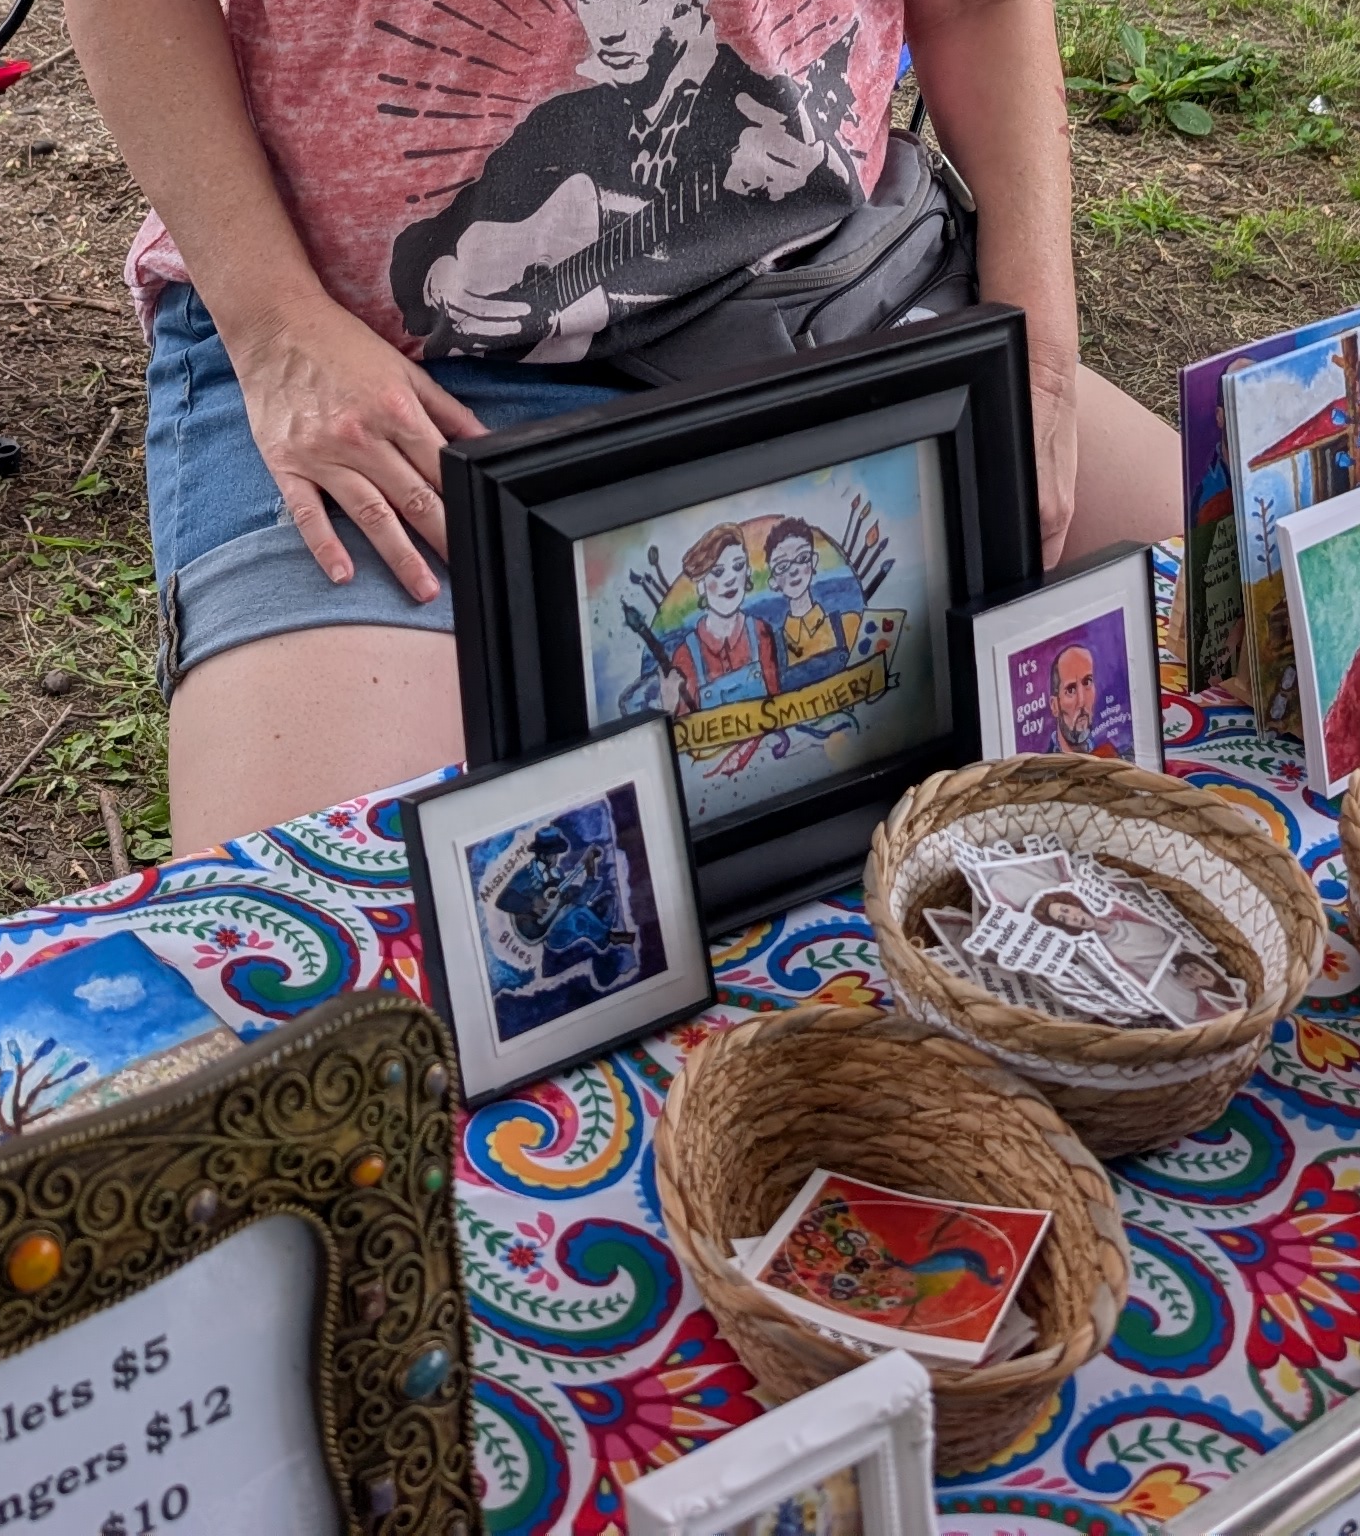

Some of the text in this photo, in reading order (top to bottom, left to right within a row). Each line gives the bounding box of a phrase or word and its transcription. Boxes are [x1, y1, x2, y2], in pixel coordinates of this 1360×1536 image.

[1018, 659, 1038, 678] It's
[1026, 681, 1034, 695] a
[674, 670, 874, 748] QUEEN SMITHERY
[1016, 692, 1046, 723] good
[1021, 716, 1044, 737] day
[499, 930, 532, 964] Blues
[968, 931, 987, 951] I'm
[988, 905, 1008, 932] great
[993, 919, 1019, 951] reader
[1003, 920, 1040, 967] that never
[1022, 929, 1056, 970] has time
[1044, 939, 1071, 974] to read
[111, 1333, 171, 1392] $5
[145, 1384, 233, 1456] $12
[100, 1482, 191, 1536] $10
